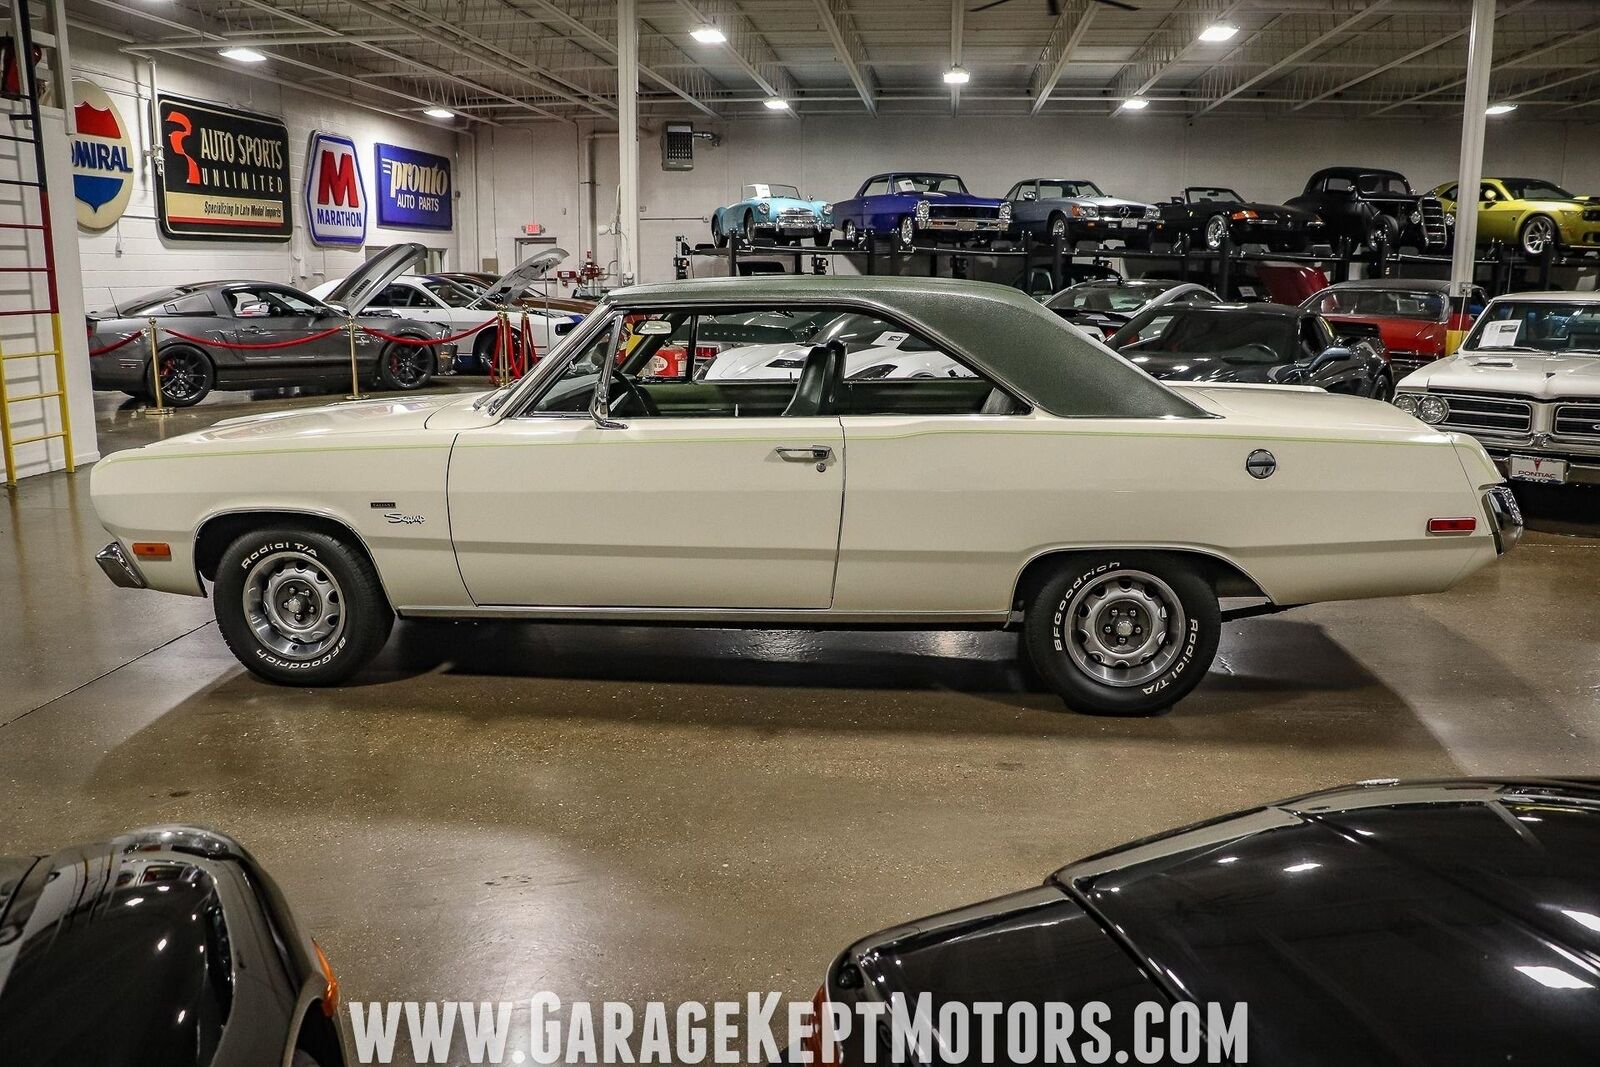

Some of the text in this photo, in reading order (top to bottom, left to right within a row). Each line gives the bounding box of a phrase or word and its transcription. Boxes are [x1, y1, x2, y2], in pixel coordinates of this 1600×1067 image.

[71, 140, 133, 172] MIRAL
[200, 127, 282, 170] AUTO SPORTS
[201, 167, 283, 193] UNLIMITED
[317, 149, 359, 208] M
[390, 160, 447, 197] pronto
[204, 200, 234, 217] Specializing
[240, 204, 250, 216] Late
[250, 204, 265, 217] Model
[264, 205, 282, 219] Imports
[317, 208, 362, 227] MARATHON
[397, 193, 440, 212] AUTO PARTS
[1518, 470, 1557, 479] PONTIAC
[240, 541, 318, 570] Radial T/A
[1053, 561, 1121, 652] BFGoodrich
[256, 636, 347, 670] BFGoodrich
[1142, 618, 1198, 696] Radial T/A
